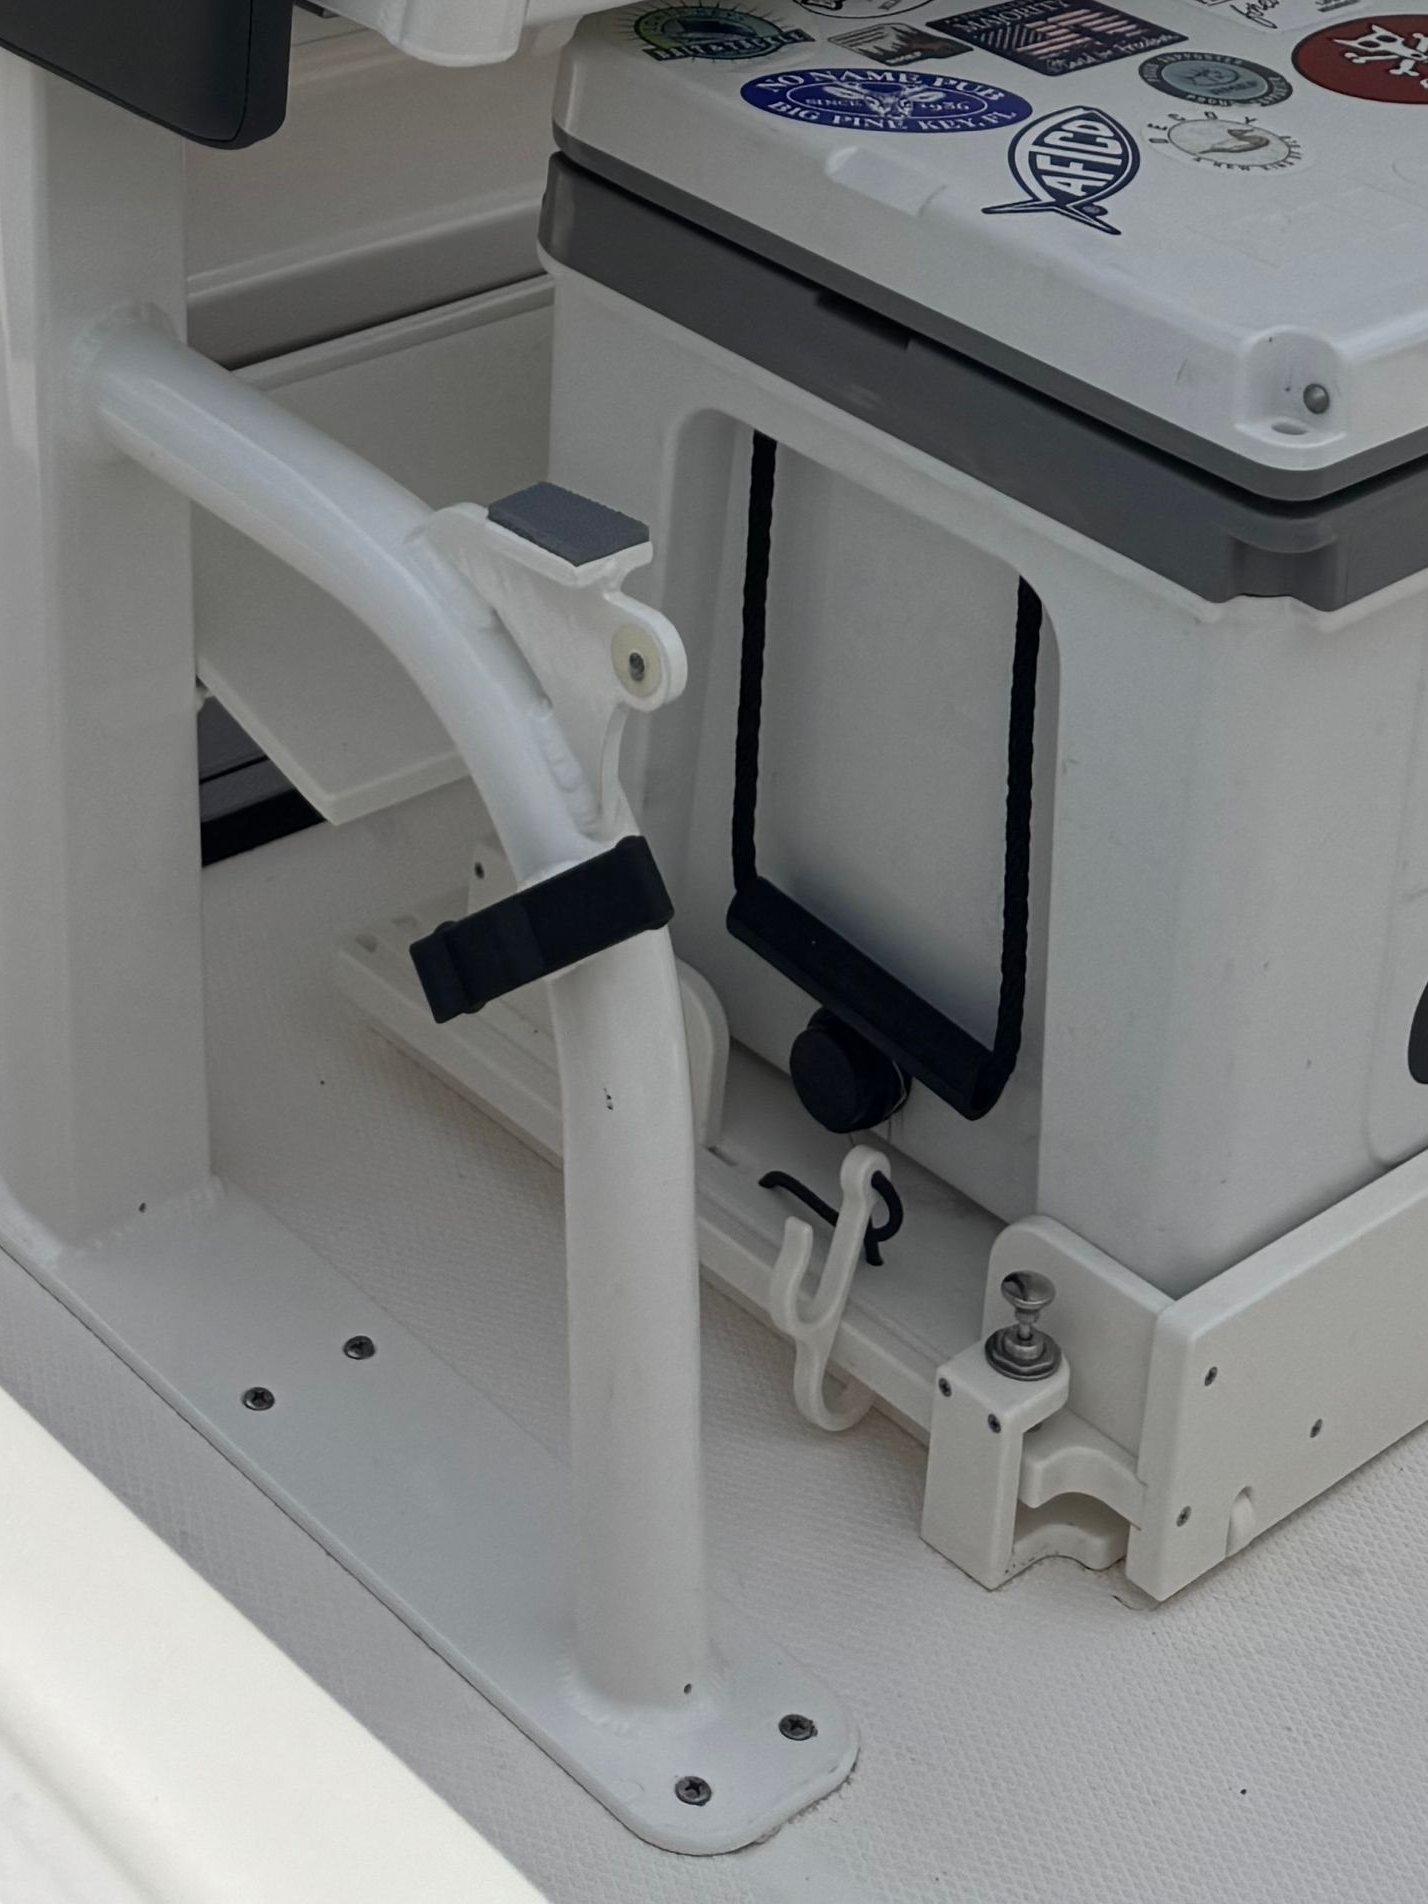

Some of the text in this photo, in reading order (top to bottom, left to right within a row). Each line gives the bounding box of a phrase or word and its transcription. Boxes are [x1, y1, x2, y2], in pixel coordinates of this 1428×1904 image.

[756, 70, 1005, 102] NO NAME PUB
[767, 101, 820, 120] BIG
[831, 114, 908, 130] PINE
[984, 110, 1018, 125] FL
[1035, 117, 1124, 197] AFTCO
